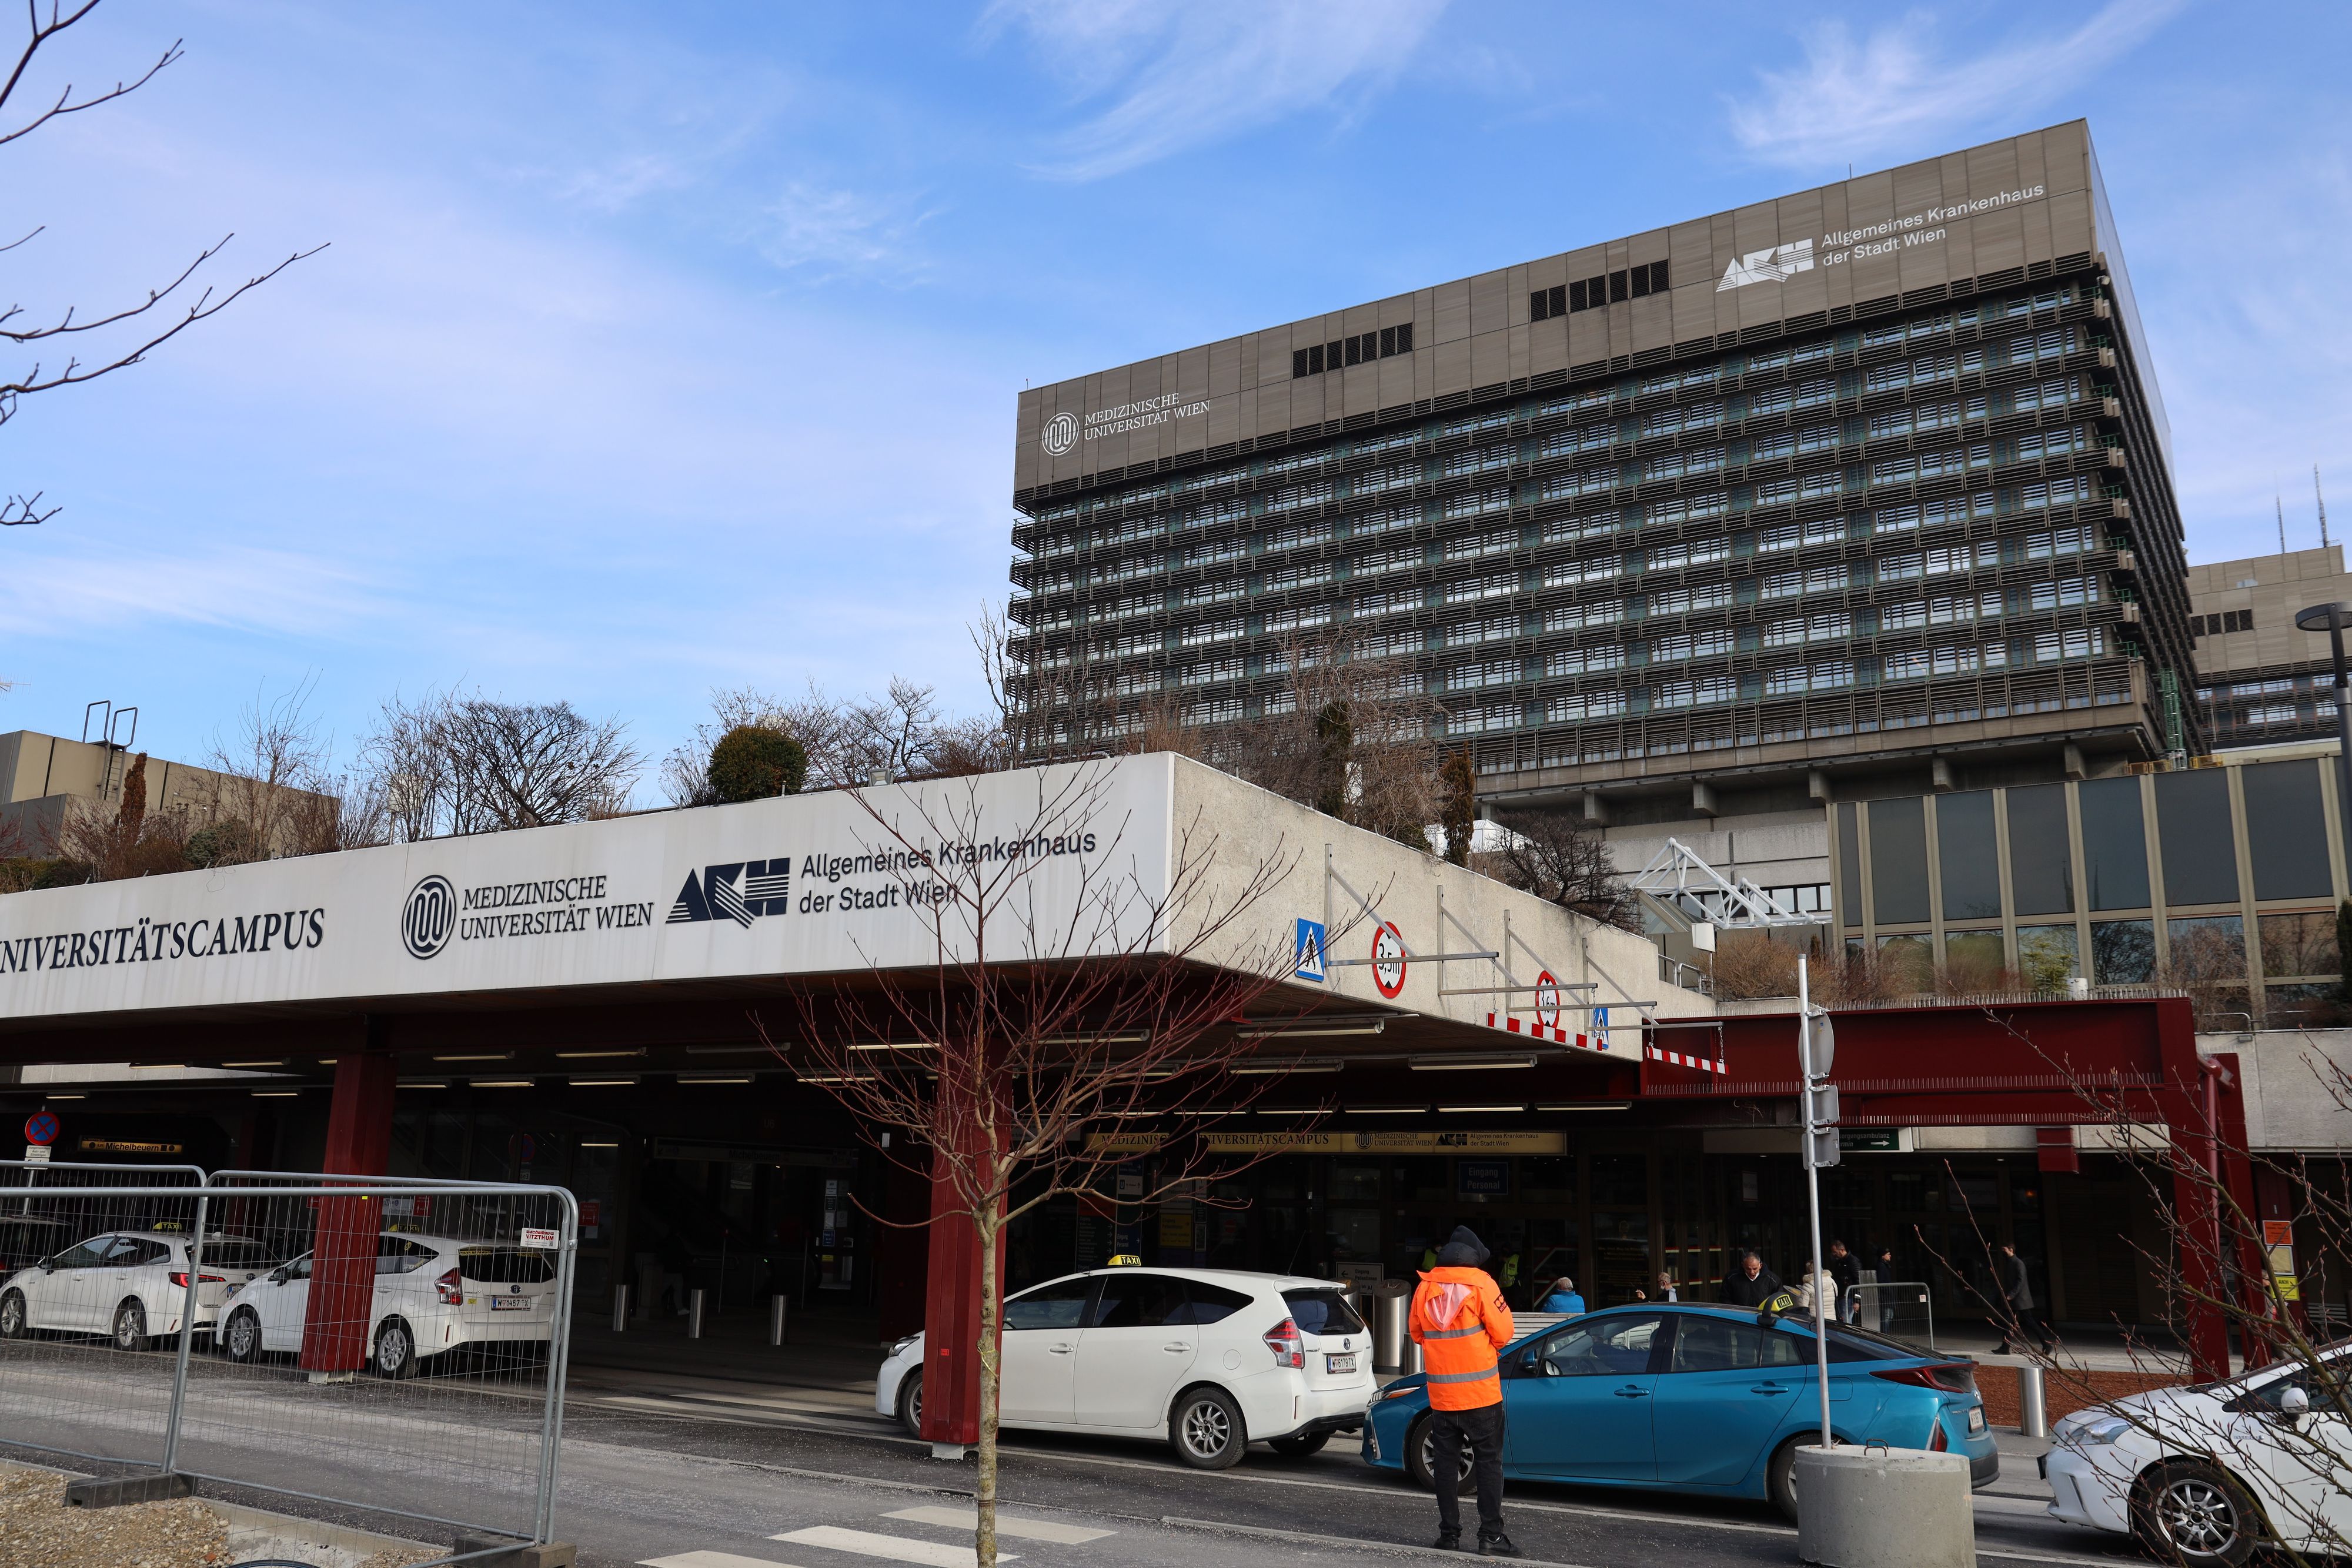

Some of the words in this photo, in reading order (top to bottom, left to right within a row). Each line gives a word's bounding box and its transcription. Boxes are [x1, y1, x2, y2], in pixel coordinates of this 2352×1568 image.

[1822, 212, 1923, 248] Allgemeines
[1927, 185, 2043, 223] Krankenhaus
[1823, 248, 1849, 267] der
[1854, 236, 1900, 260] Stadt
[1903, 228, 1946, 247] Wien
[1084, 392, 1180, 426] MEDIZINISCHE
[1084, 409, 1168, 440] UNIVERSITÄT
[1174, 400, 1210, 420] WIEN
[801, 847, 932, 883] Allgemeines
[939, 832, 1096, 866] Krankenhaus
[462, 875, 608, 911] MEDIZINISCHE
[800, 891, 834, 913] der
[839, 883, 898, 910] Stadt
[905, 879, 959, 905] Wien
[460, 904, 590, 940] UNIVERSITÄT
[596, 902, 654, 928] WIEN
[0, 908, 325, 974] NIVERSITÄTSCAMPUS
[106, 1142, 159, 1152] Michelbeuern
[1200, 1132, 1329, 1145] NIVERSITÄTSCAMPUS
[46, 1173, 88, 1185] Aufzug
[1468, 1180, 1499, 1189] Personal
[1469, 1167, 1499, 1178] Eingang
[1121, 1256, 1140, 1265] TAXI
[1778, 1296, 1789, 1308] TAXI
[1338, 1358, 1348, 1368] 6179
[1349, 1358, 1354, 1367] TX
